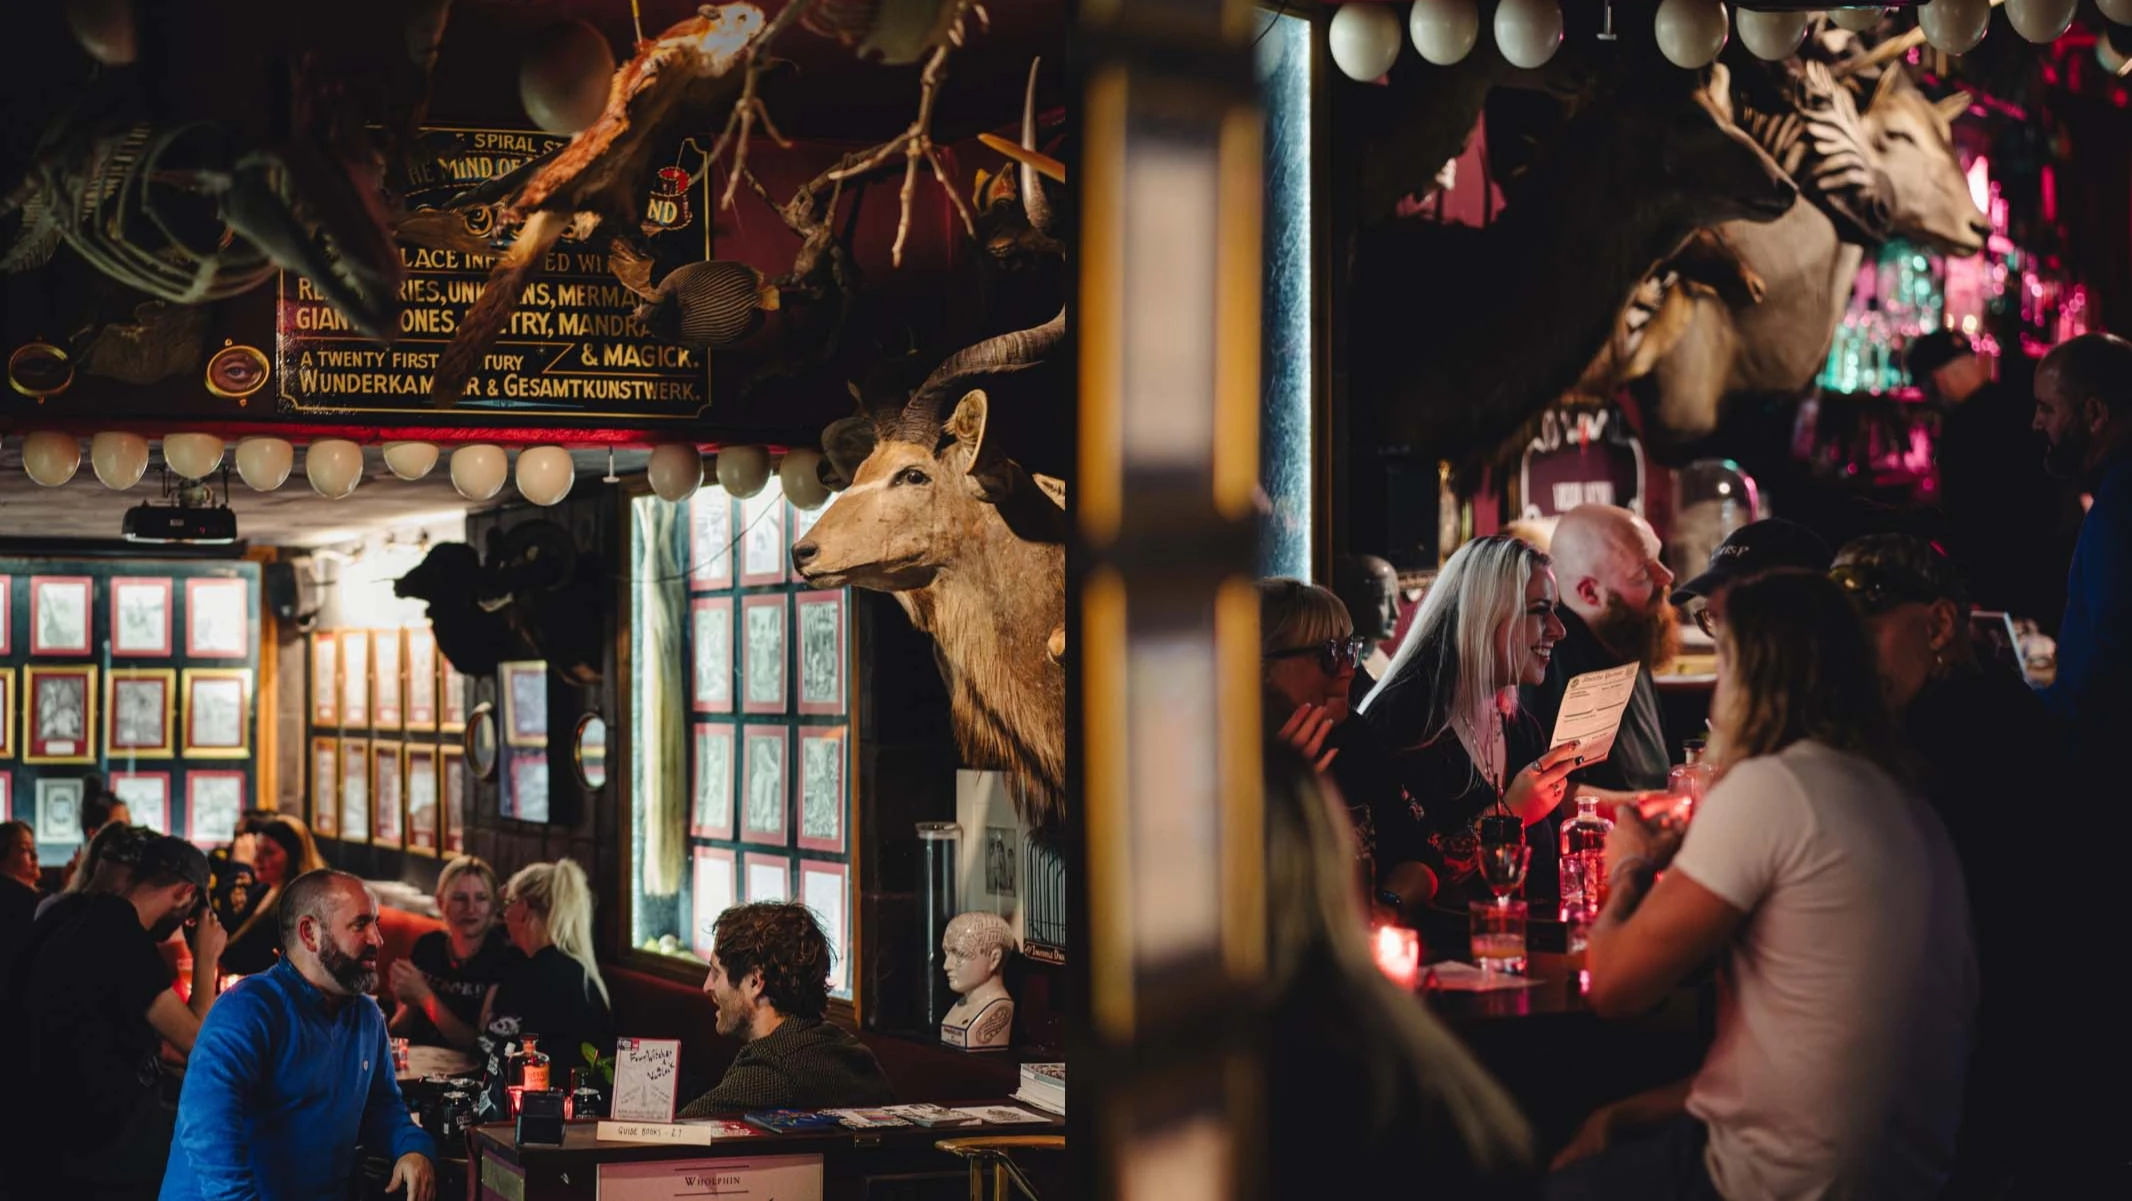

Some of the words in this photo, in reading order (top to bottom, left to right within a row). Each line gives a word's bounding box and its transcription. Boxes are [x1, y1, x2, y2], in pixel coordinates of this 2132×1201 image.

[474, 132, 537, 153] SPIRAL
[437, 156, 494, 181] MIND
[497, 156, 522, 177] OF
[400, 247, 460, 271] LACE
[400, 308, 460, 333] ONES,
[301, 352, 313, 367] A
[317, 351, 386, 368] TWENTY
[392, 352, 439, 369] FIRST
[581, 343, 598, 366] &
[604, 343, 700, 368] MAGICK.
[486, 378, 500, 398] &
[503, 372, 701, 402] GESAMTKUNSTWERK.
[618, 1126, 638, 1137] GUIDE
[641, 1127, 661, 1137] BOOKS
